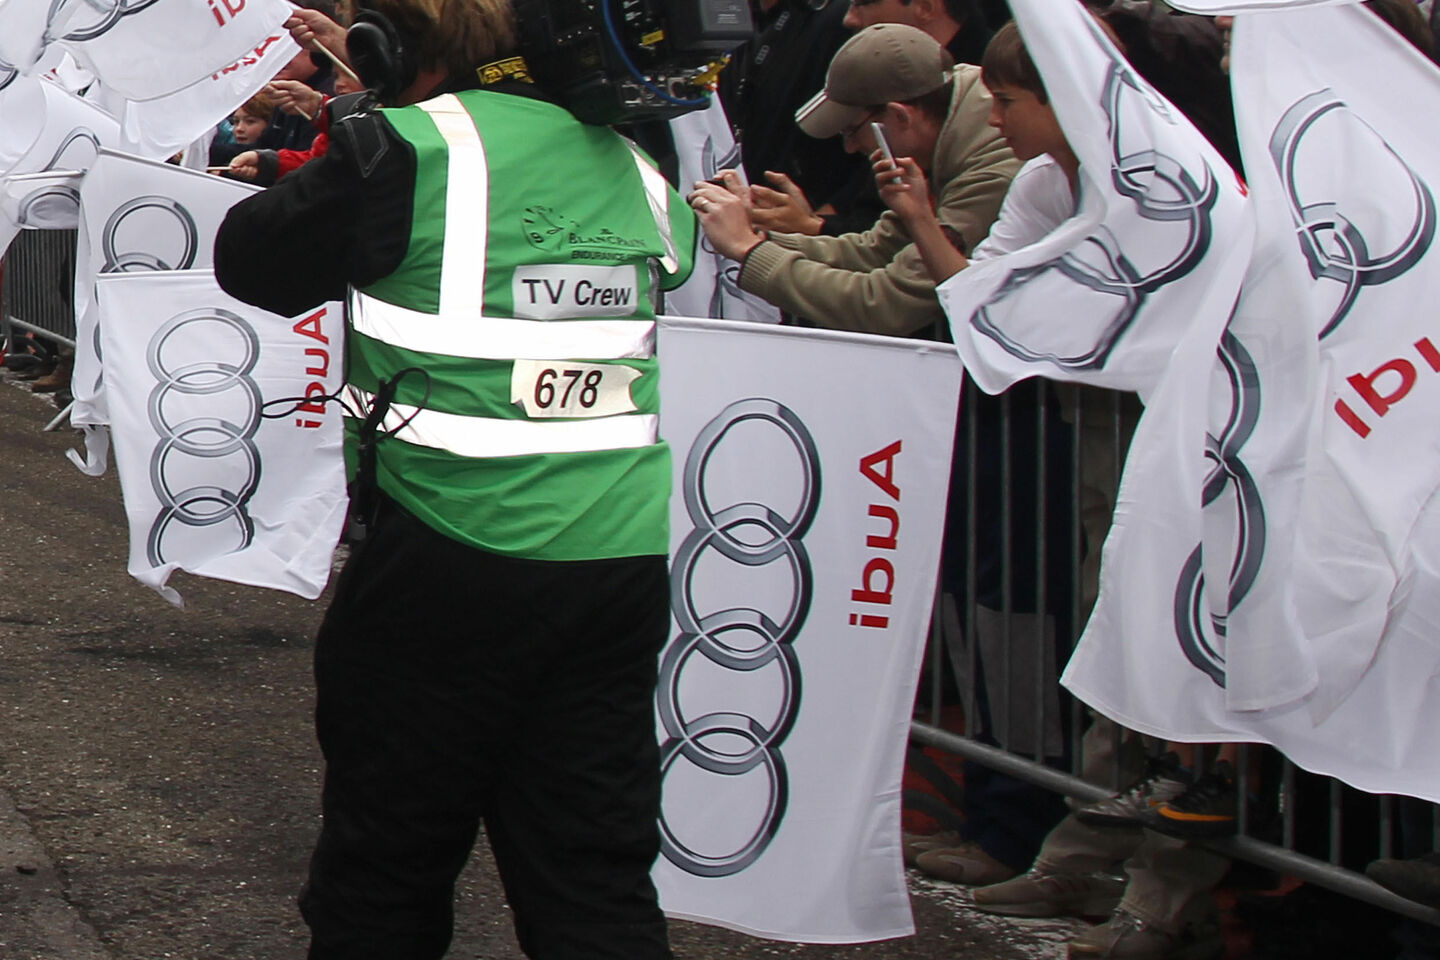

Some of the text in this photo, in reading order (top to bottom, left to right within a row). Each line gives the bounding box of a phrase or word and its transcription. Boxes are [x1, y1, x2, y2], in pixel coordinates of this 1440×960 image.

[522, 279, 632, 306] TV Crew
[534, 368, 603, 409] 678
